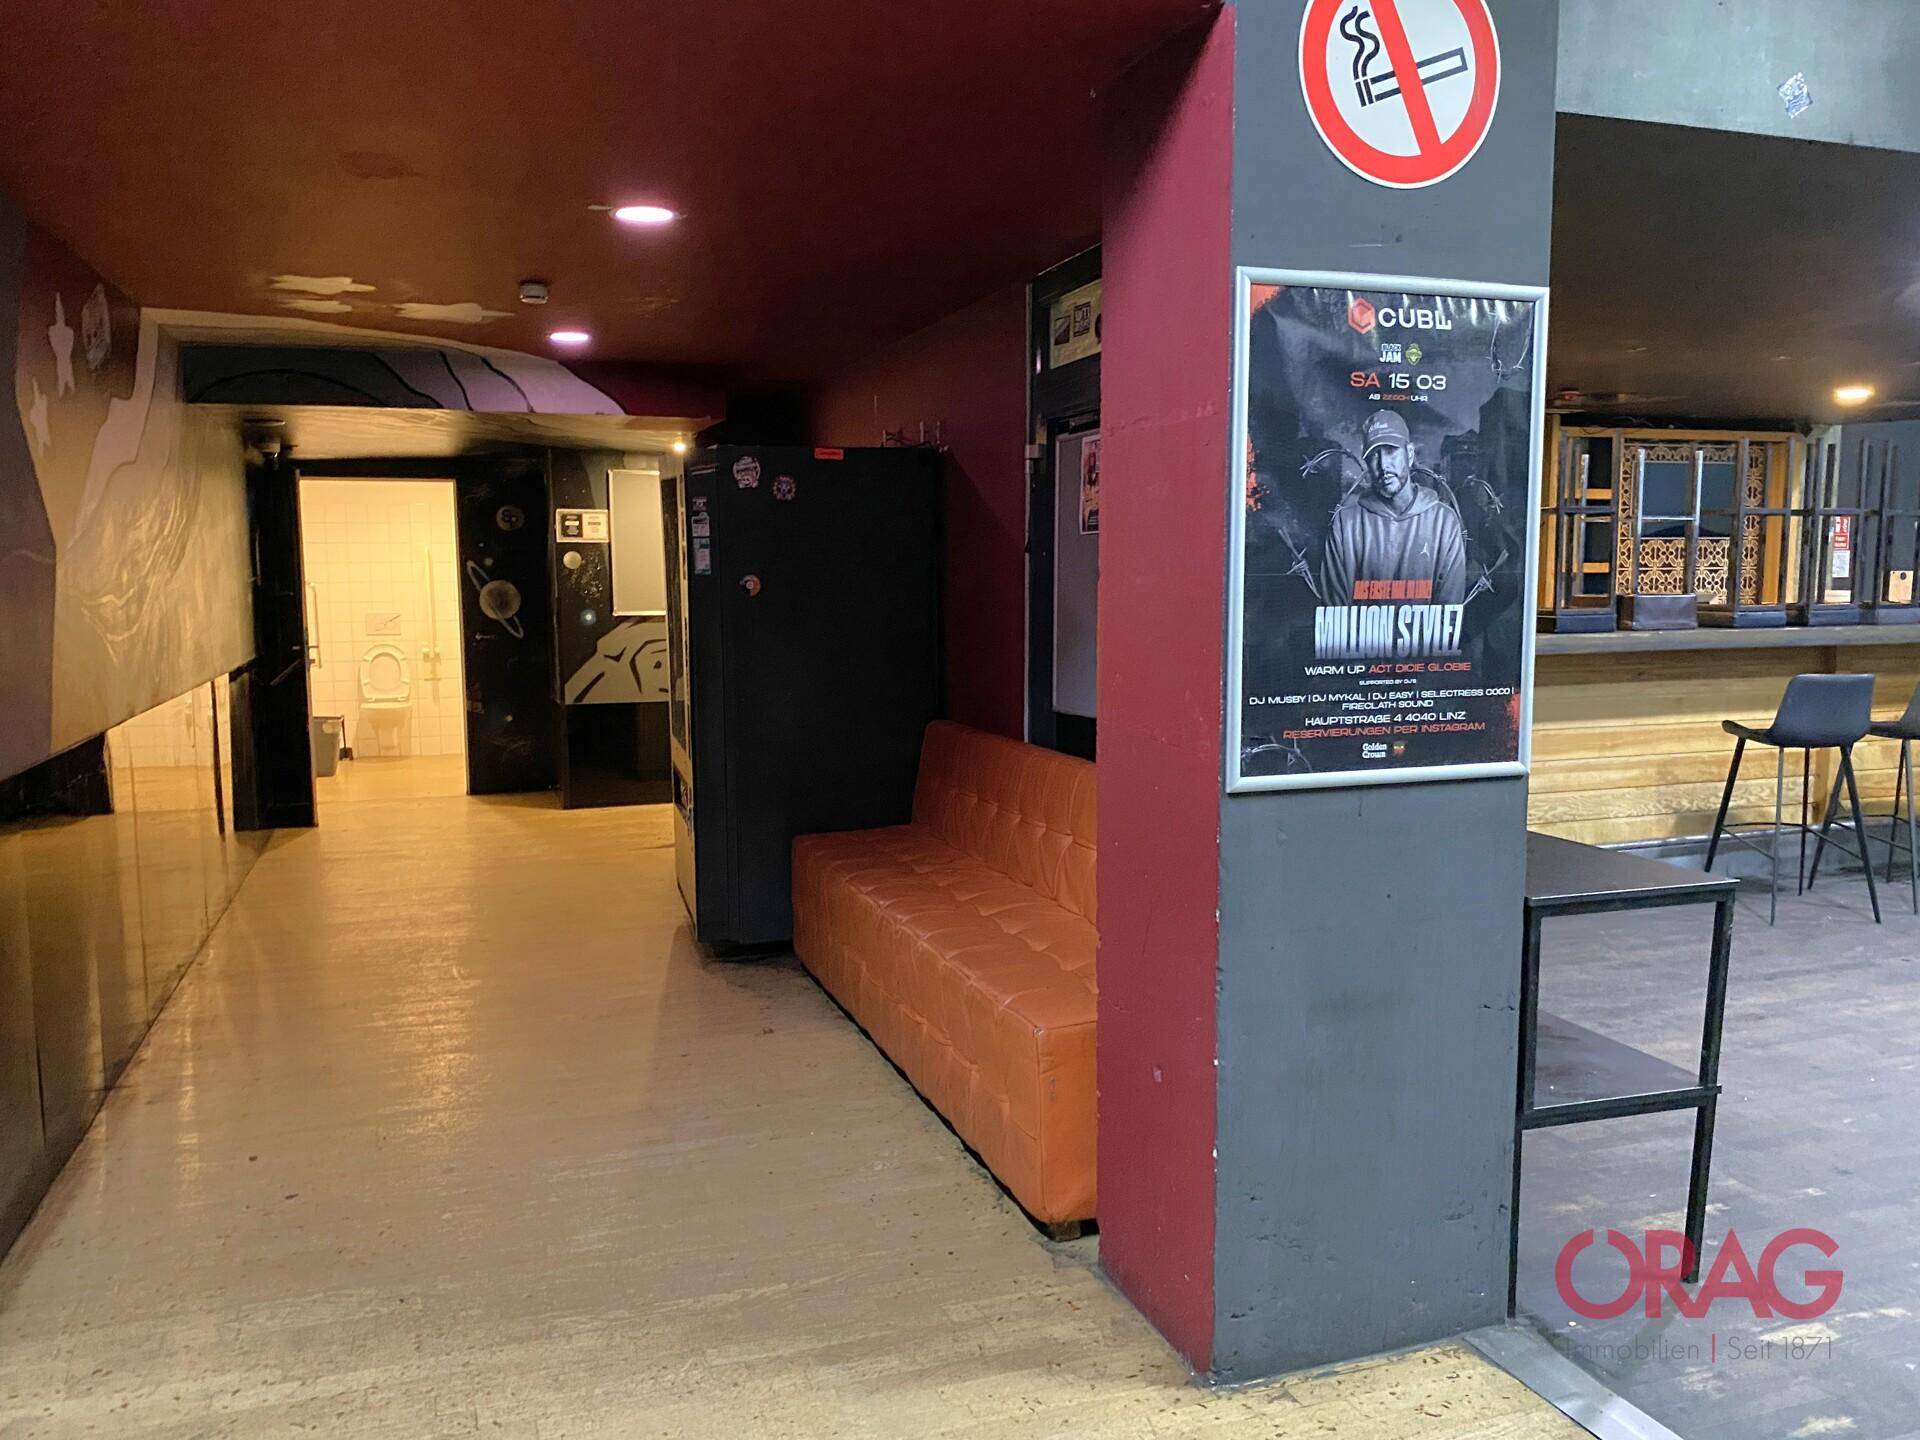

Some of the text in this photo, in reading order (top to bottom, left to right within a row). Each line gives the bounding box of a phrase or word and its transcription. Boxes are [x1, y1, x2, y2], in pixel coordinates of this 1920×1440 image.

[1379, 351, 1402, 363] JAM
[1350, 371, 1447, 390] SA 15 03
[1315, 604, 1464, 659] MILLION STYLEZ
[1305, 666, 1344, 676] WARM
[1347, 665, 1366, 675] UP
[1249, 696, 1265, 705] DJ
[1268, 695, 1306, 704] MUSBY
[1312, 694, 1326, 703] DJ
[1329, 693, 1366, 702] MYKAL
[1373, 692, 1387, 700] DJ
[1389, 691, 1414, 700] EASY
[1421, 689, 1483, 698] SELECTRESS
[1486, 687, 1511, 696] COCO
[1342, 700, 1434, 711] FIRECLATH SOUND
[1394, 713, 1401, 722] 4
[1405, 712, 1436, 722] 4040
[1439, 711, 1466, 721] LINZ
[1283, 722, 1486, 739] RESERVIERUNGEN PER INSTAGRAM
[1362, 742, 1387, 751] Golden
